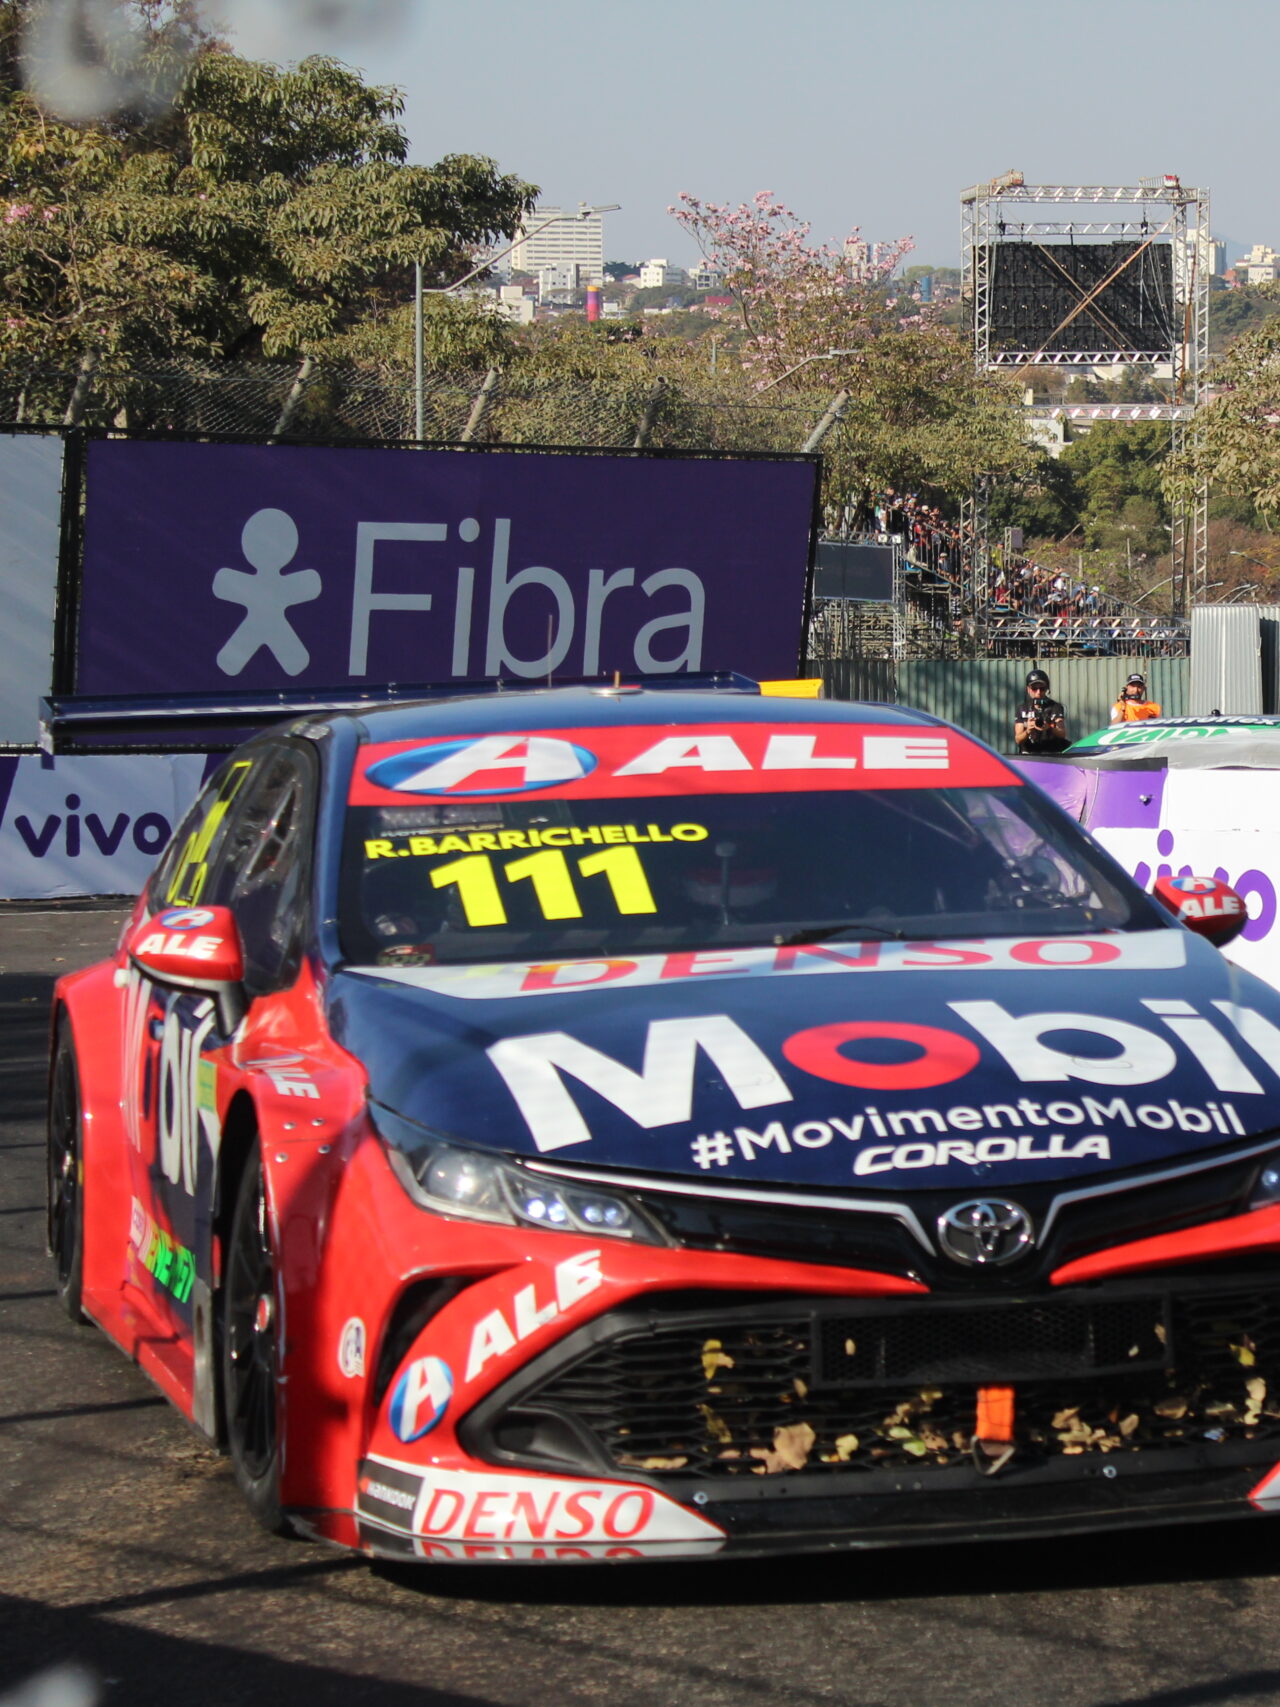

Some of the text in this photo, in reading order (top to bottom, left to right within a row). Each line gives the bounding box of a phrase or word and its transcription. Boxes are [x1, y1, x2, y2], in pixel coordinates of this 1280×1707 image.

[348, 517, 707, 679] Fibra
[612, 735, 950, 777] ALE
[14, 793, 172, 858] vivo
[364, 822, 709, 859] R.BARRICHELLO
[429, 845, 658, 927] 111
[1178, 895, 1241, 919] ALE
[136, 933, 224, 959] ALE
[520, 939, 1122, 992] DENSO
[691, 1096, 1247, 1170] #MovimentoMobil
[852, 1135, 1111, 1176] COROLLA
[464, 1249, 603, 1384] ALE
[420, 1487, 655, 1540] DENSO
